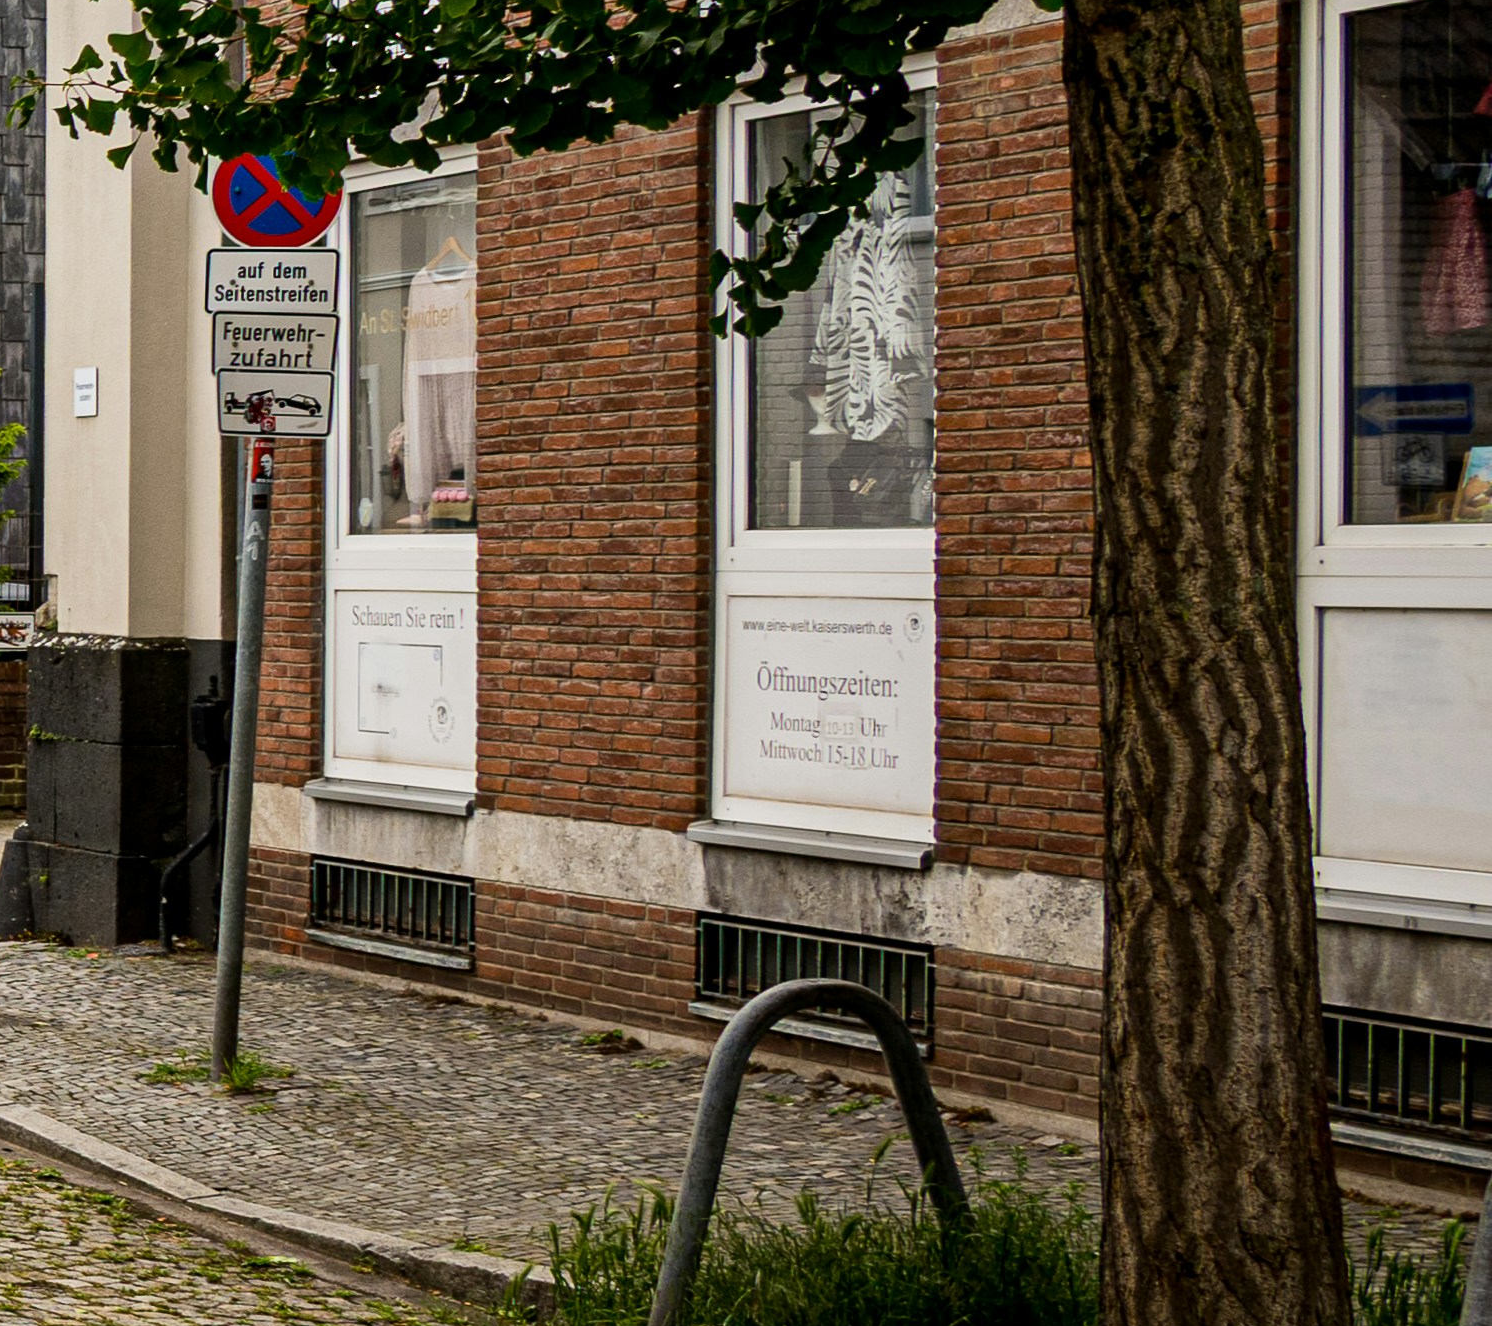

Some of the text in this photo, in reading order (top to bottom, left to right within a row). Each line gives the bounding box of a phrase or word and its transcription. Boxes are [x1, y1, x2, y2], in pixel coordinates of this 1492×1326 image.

[237, 261, 307, 279] auf dem
[214, 284, 329, 303] Seitenstreifen
[222, 320, 325, 343] Feuerwehr-
[359, 311, 377, 335] An
[229, 347, 313, 369] zufahrt
[352, 605, 464, 630] Schauen Sie rein !
[757, 660, 899, 702] Öffnungszeiten:
[770, 711, 887, 739] Montag 10-13 Uhr
[759, 739, 899, 770] Mittwoch 15-18 Uhr
